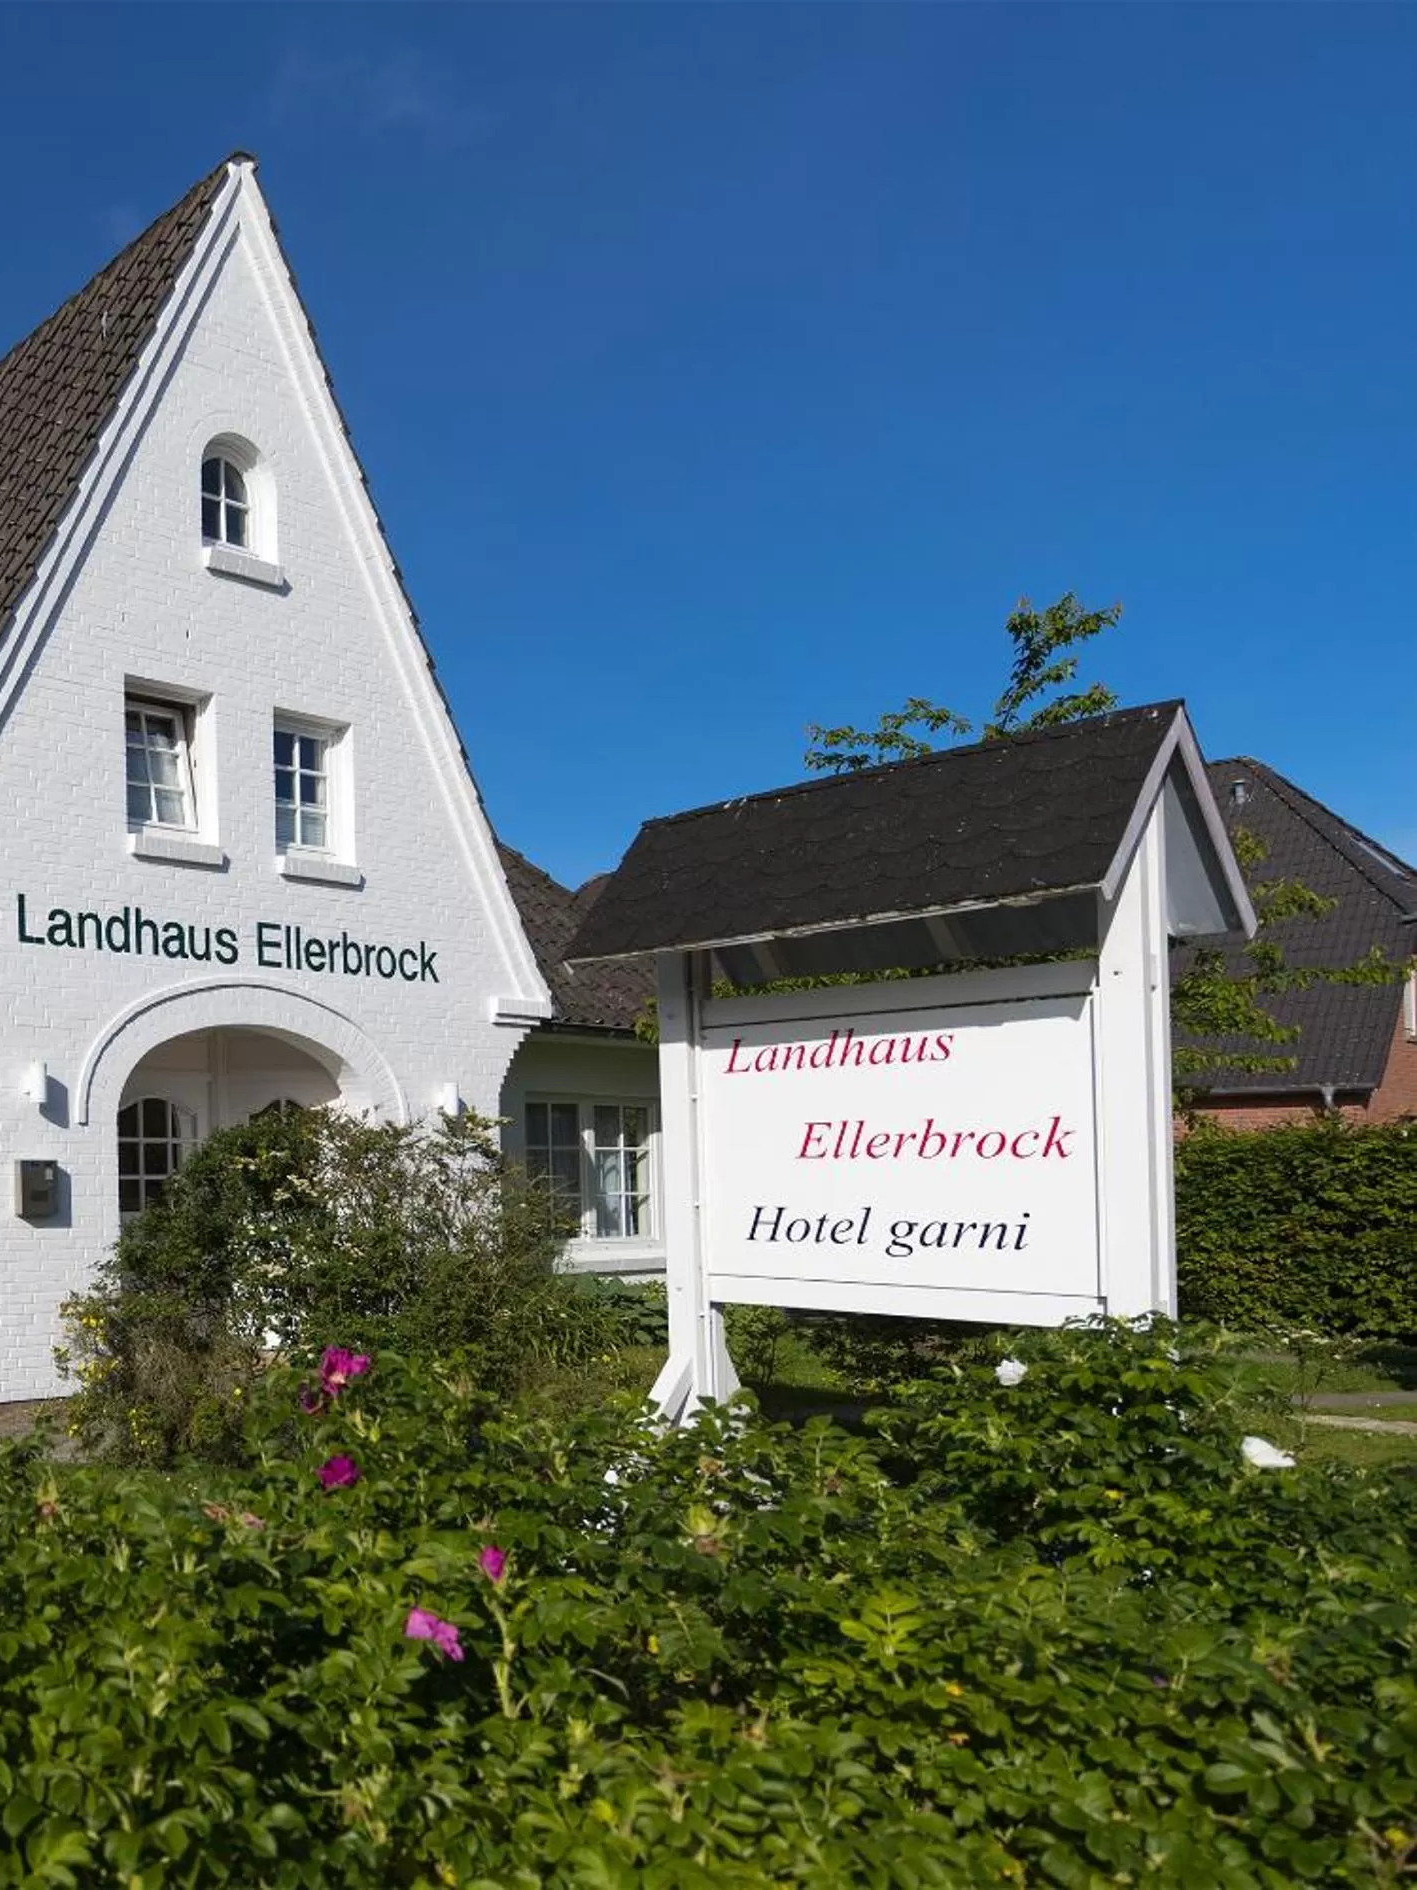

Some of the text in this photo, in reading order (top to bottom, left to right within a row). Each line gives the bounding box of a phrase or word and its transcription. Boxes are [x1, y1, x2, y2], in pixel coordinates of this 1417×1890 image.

[17, 893, 440, 983] Landhaus Ellerbrock
[724, 1027, 954, 1074] Landhaus
[796, 1116, 1076, 1160] Ellerbrock
[746, 1206, 1031, 1258] Hotel garni
